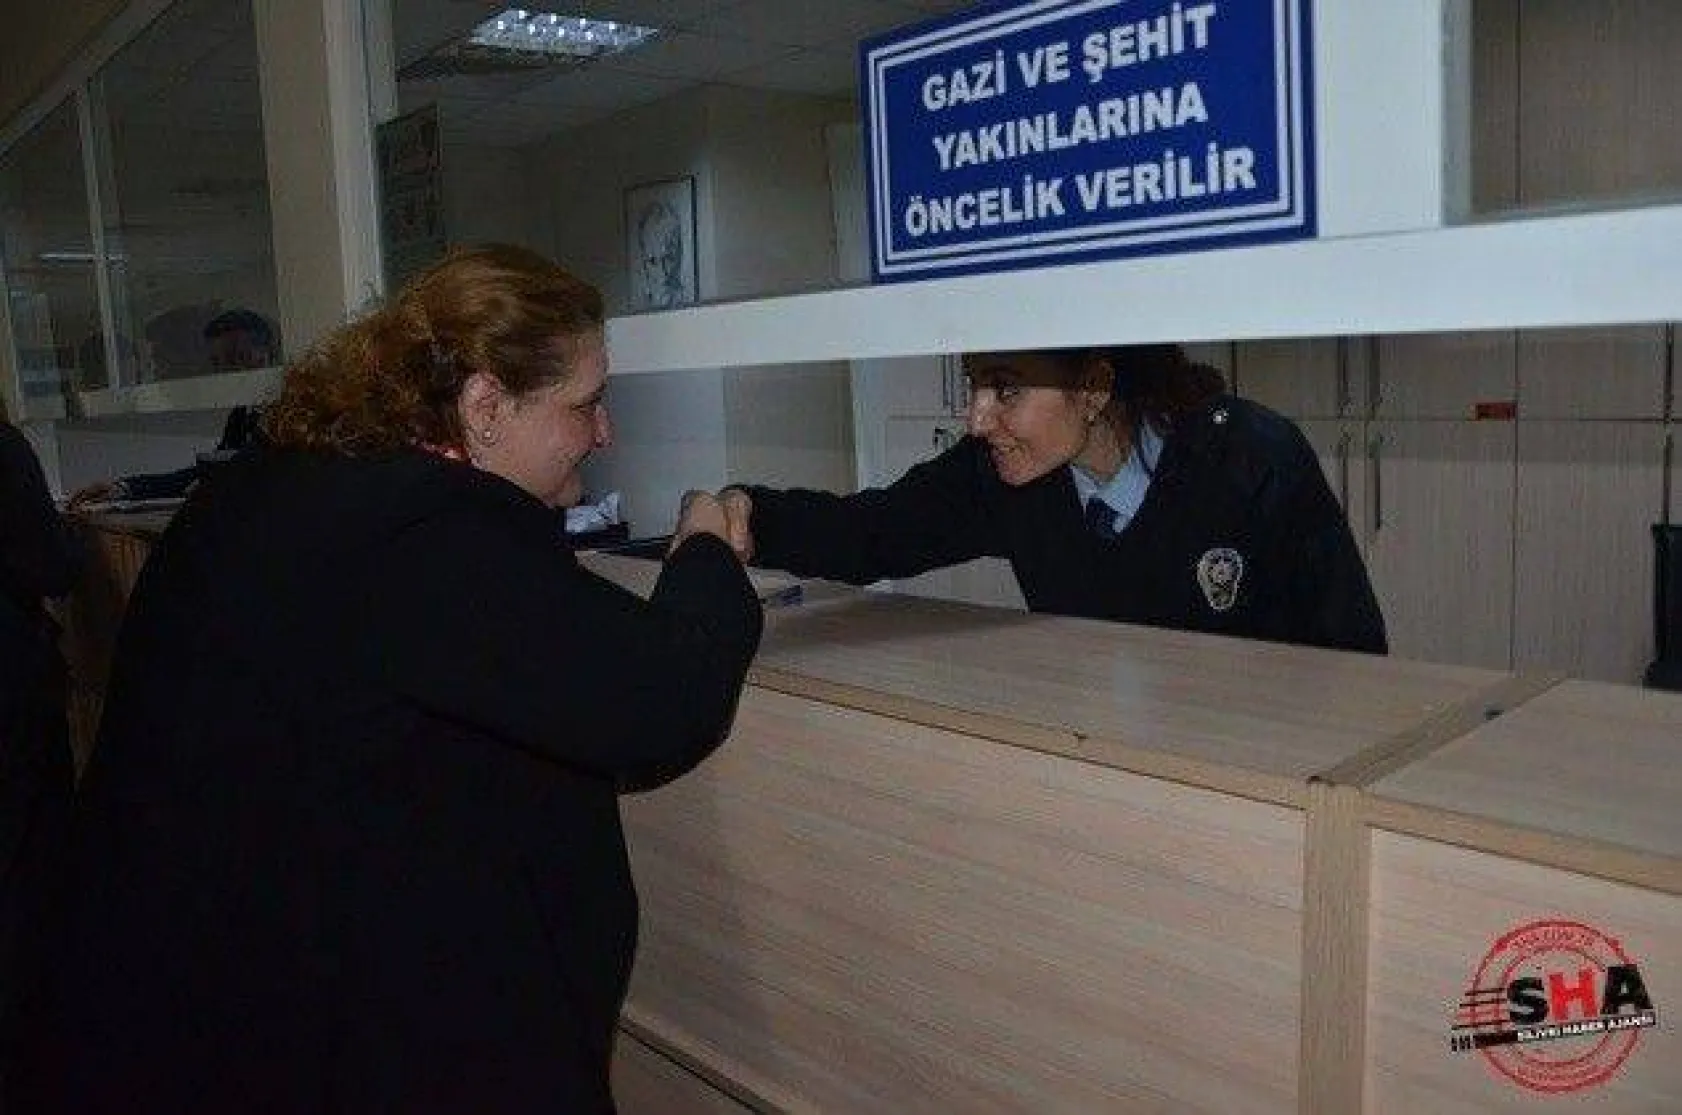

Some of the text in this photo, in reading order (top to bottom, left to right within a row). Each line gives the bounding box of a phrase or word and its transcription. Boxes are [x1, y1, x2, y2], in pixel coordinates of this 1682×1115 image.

[922, 2, 1217, 113] GAZİ VE ŞEHİT
[933, 81, 1210, 172] YAKINLARINA
[904, 142, 1258, 238] ÖNCELİK VERİLİR
